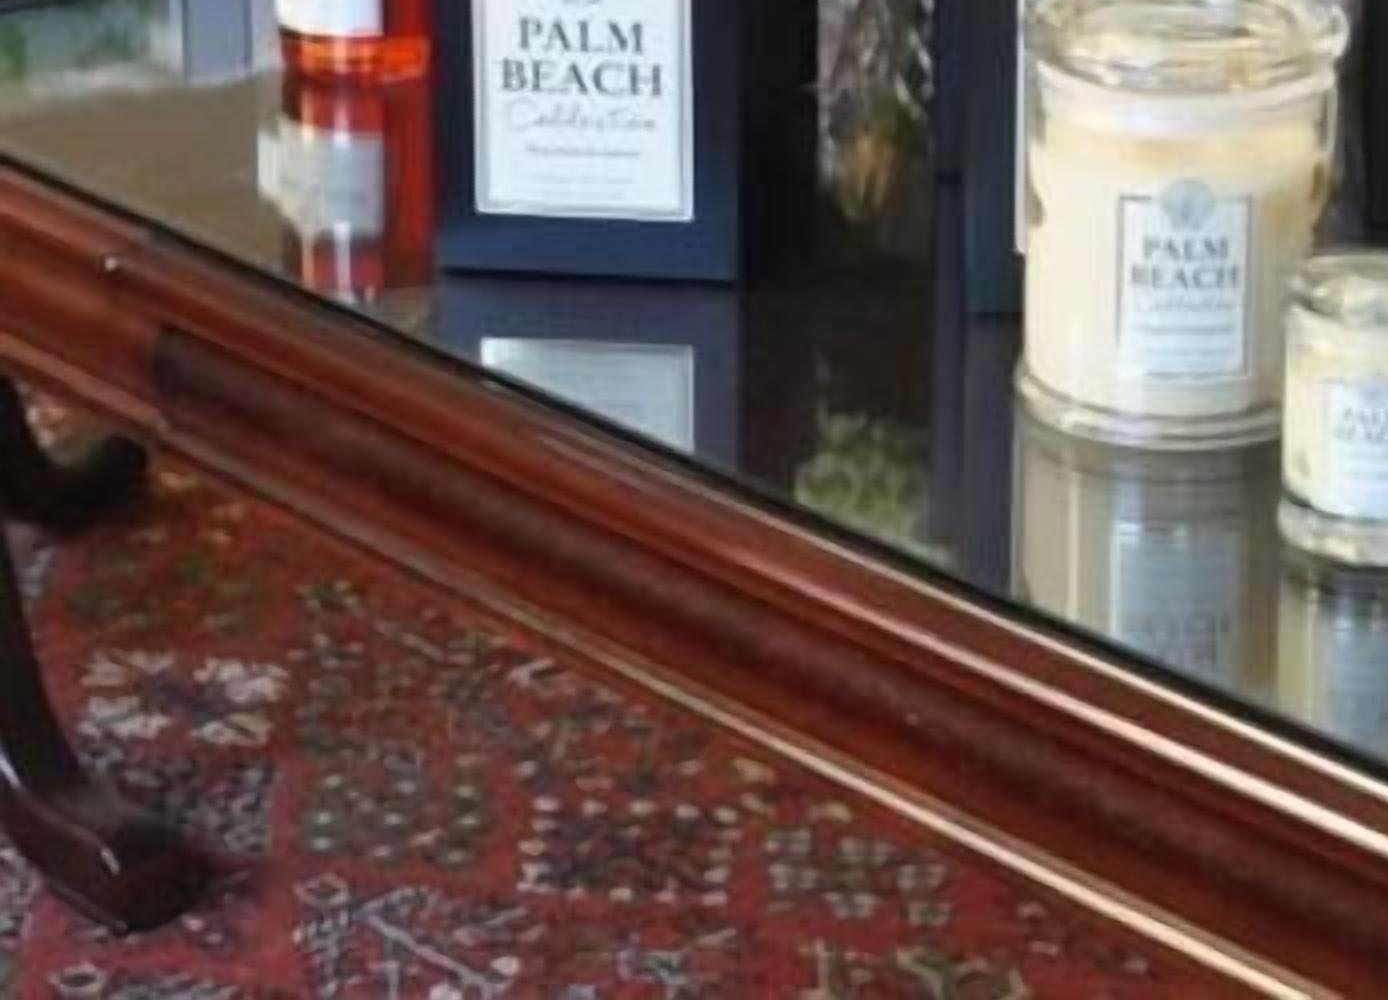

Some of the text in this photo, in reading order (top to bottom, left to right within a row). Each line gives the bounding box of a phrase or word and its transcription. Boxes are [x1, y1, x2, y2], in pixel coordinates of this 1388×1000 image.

[518, 15, 645, 55] PALM
[500, 56, 664, 97] BEACH
[1142, 235, 1230, 262] PALM
[1131, 263, 1240, 290] BEACH
